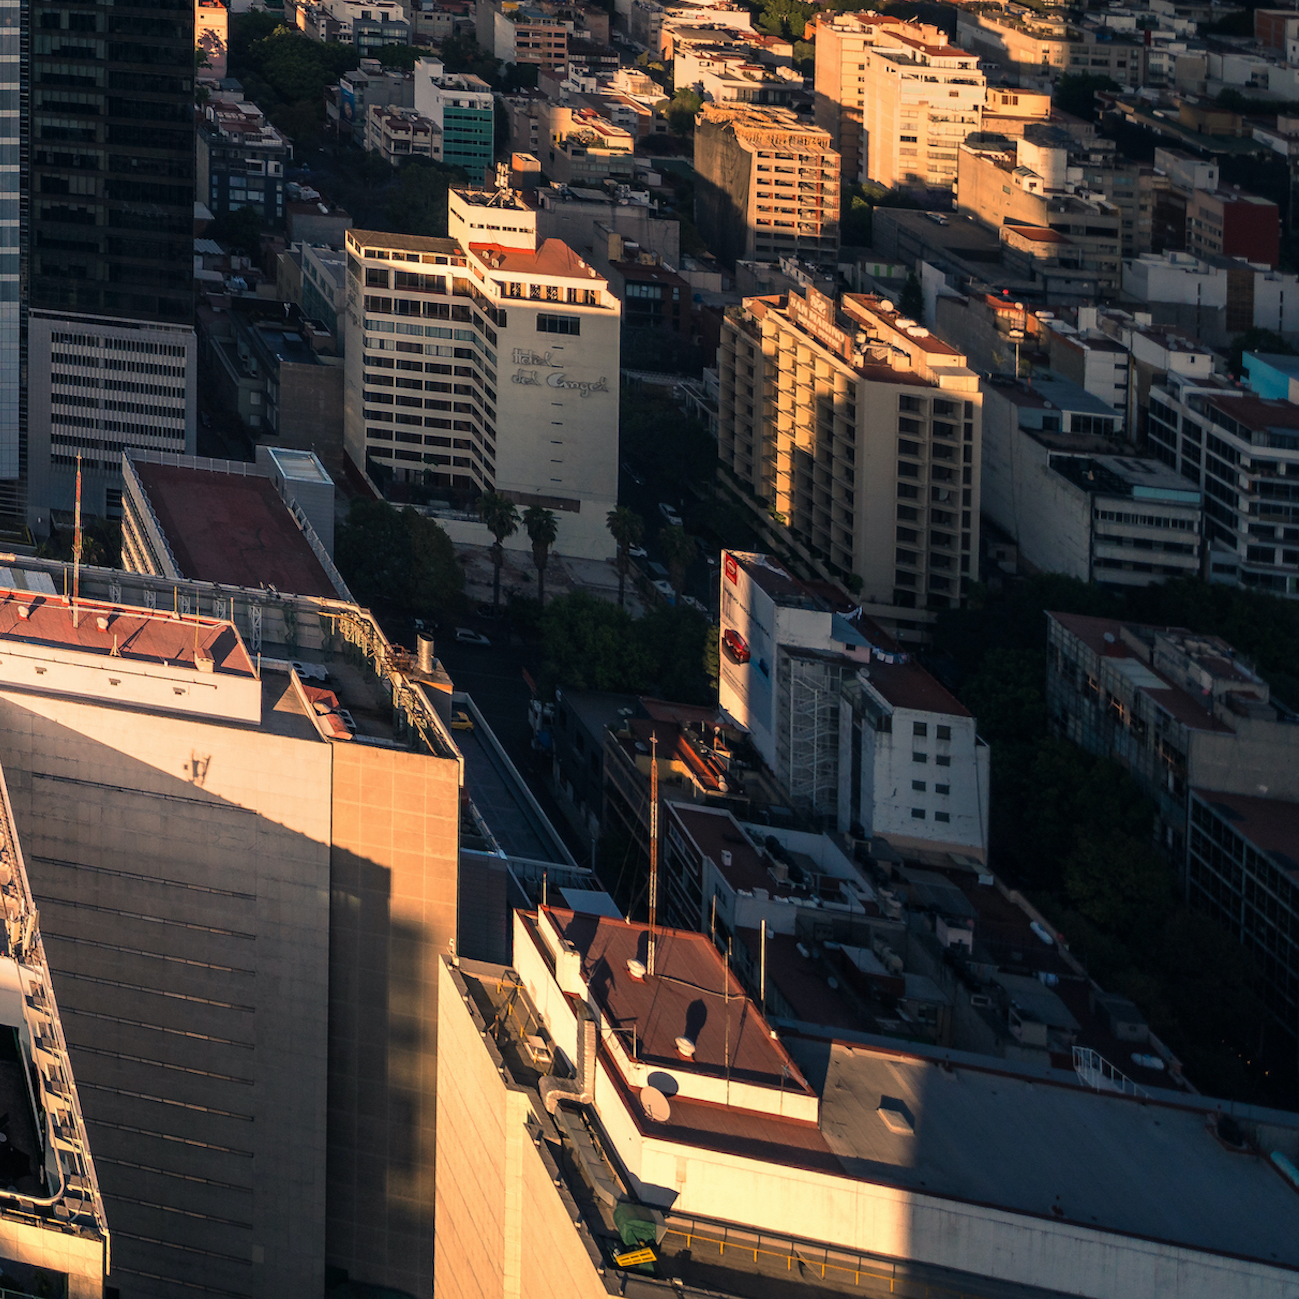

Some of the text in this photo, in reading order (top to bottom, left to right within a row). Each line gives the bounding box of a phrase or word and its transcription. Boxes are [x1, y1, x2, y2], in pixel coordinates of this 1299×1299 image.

[789, 296, 845, 343] SAN MARINO
[511, 347, 553, 367] Hotel
[511, 368, 541, 386] del
